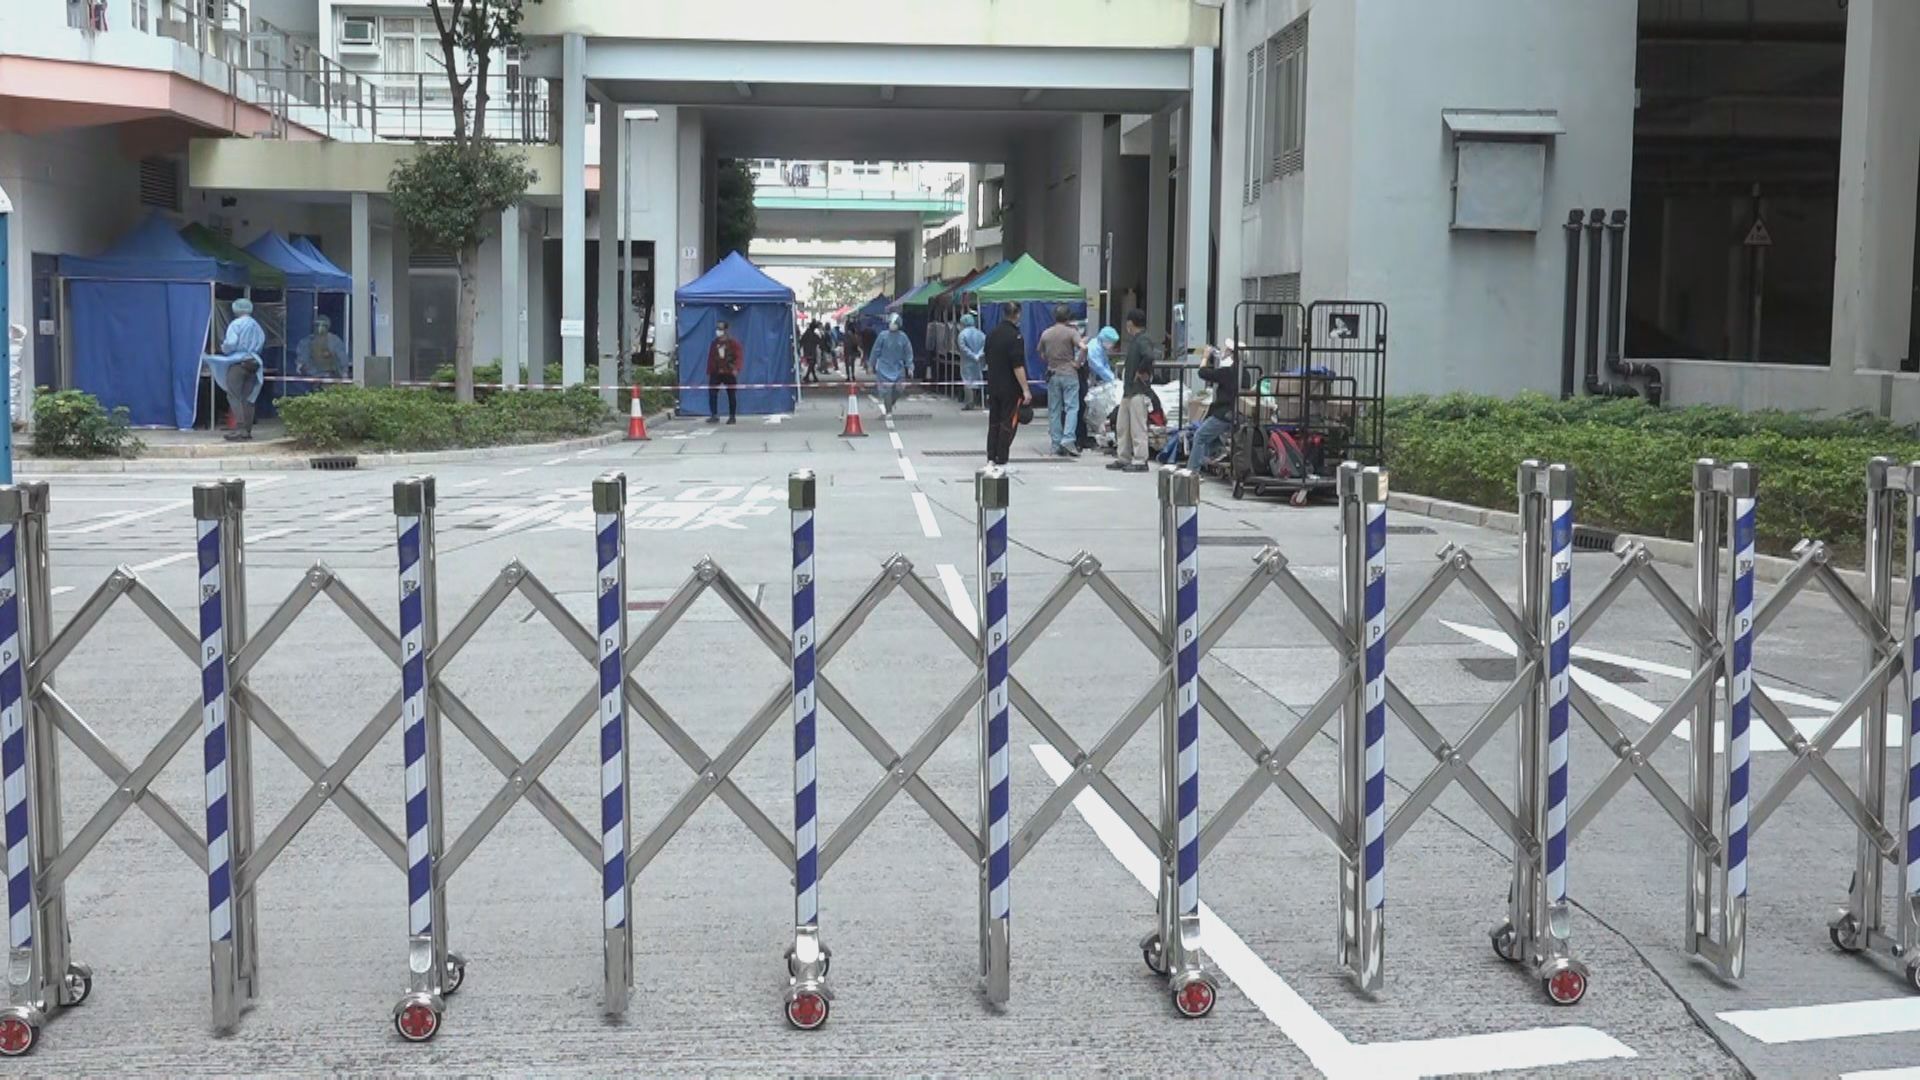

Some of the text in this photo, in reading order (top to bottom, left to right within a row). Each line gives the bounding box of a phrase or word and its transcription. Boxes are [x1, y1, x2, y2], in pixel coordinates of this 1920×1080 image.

[1373, 625, 1380, 639] P
[1557, 620, 1565, 633] P
[1741, 618, 1749, 632] P
[800, 635, 808, 648] P
[994, 632, 1002, 646] P
[1184, 628, 1192, 643] P
[408, 642, 416, 656] P
[605, 638, 613, 652] P
[3, 650, 12, 664] P
[207, 646, 215, 660] P
